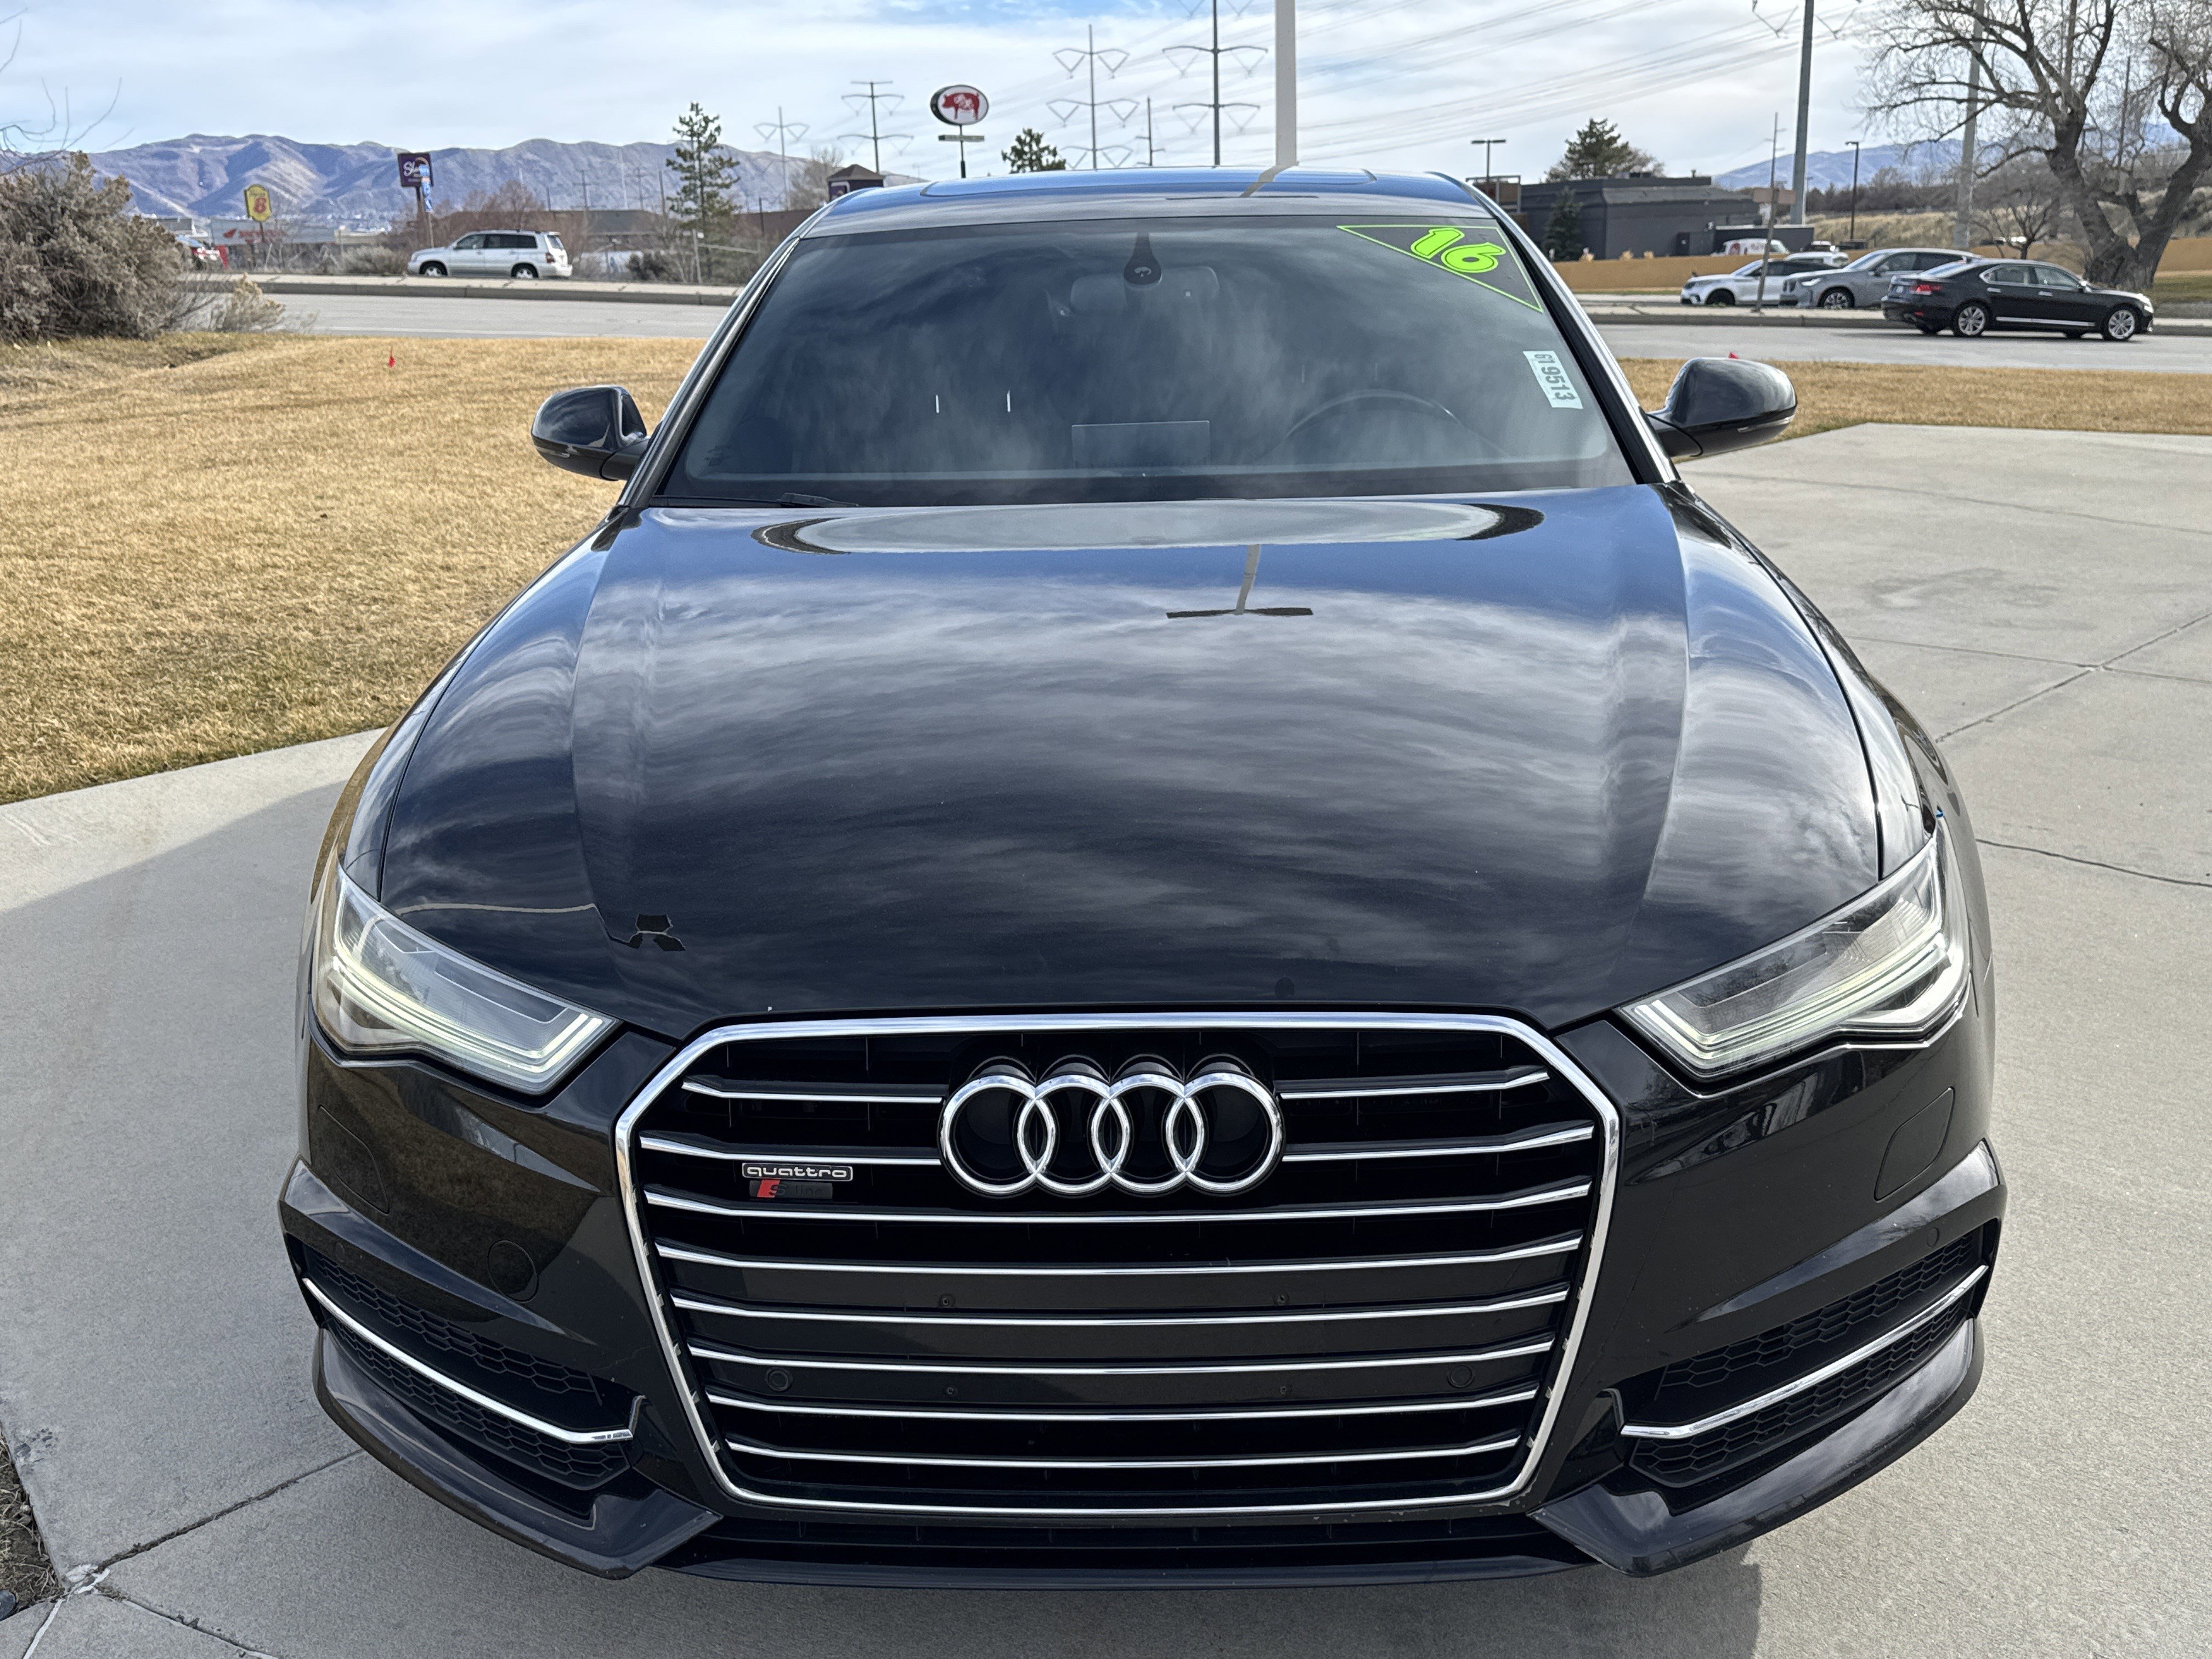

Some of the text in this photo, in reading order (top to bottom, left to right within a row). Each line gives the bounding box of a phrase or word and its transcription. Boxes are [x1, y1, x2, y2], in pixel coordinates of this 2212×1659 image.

[254, 197, 267, 214] 8
[1410, 228, 1506, 273] 16
[747, 1166, 847, 1177] quattro
